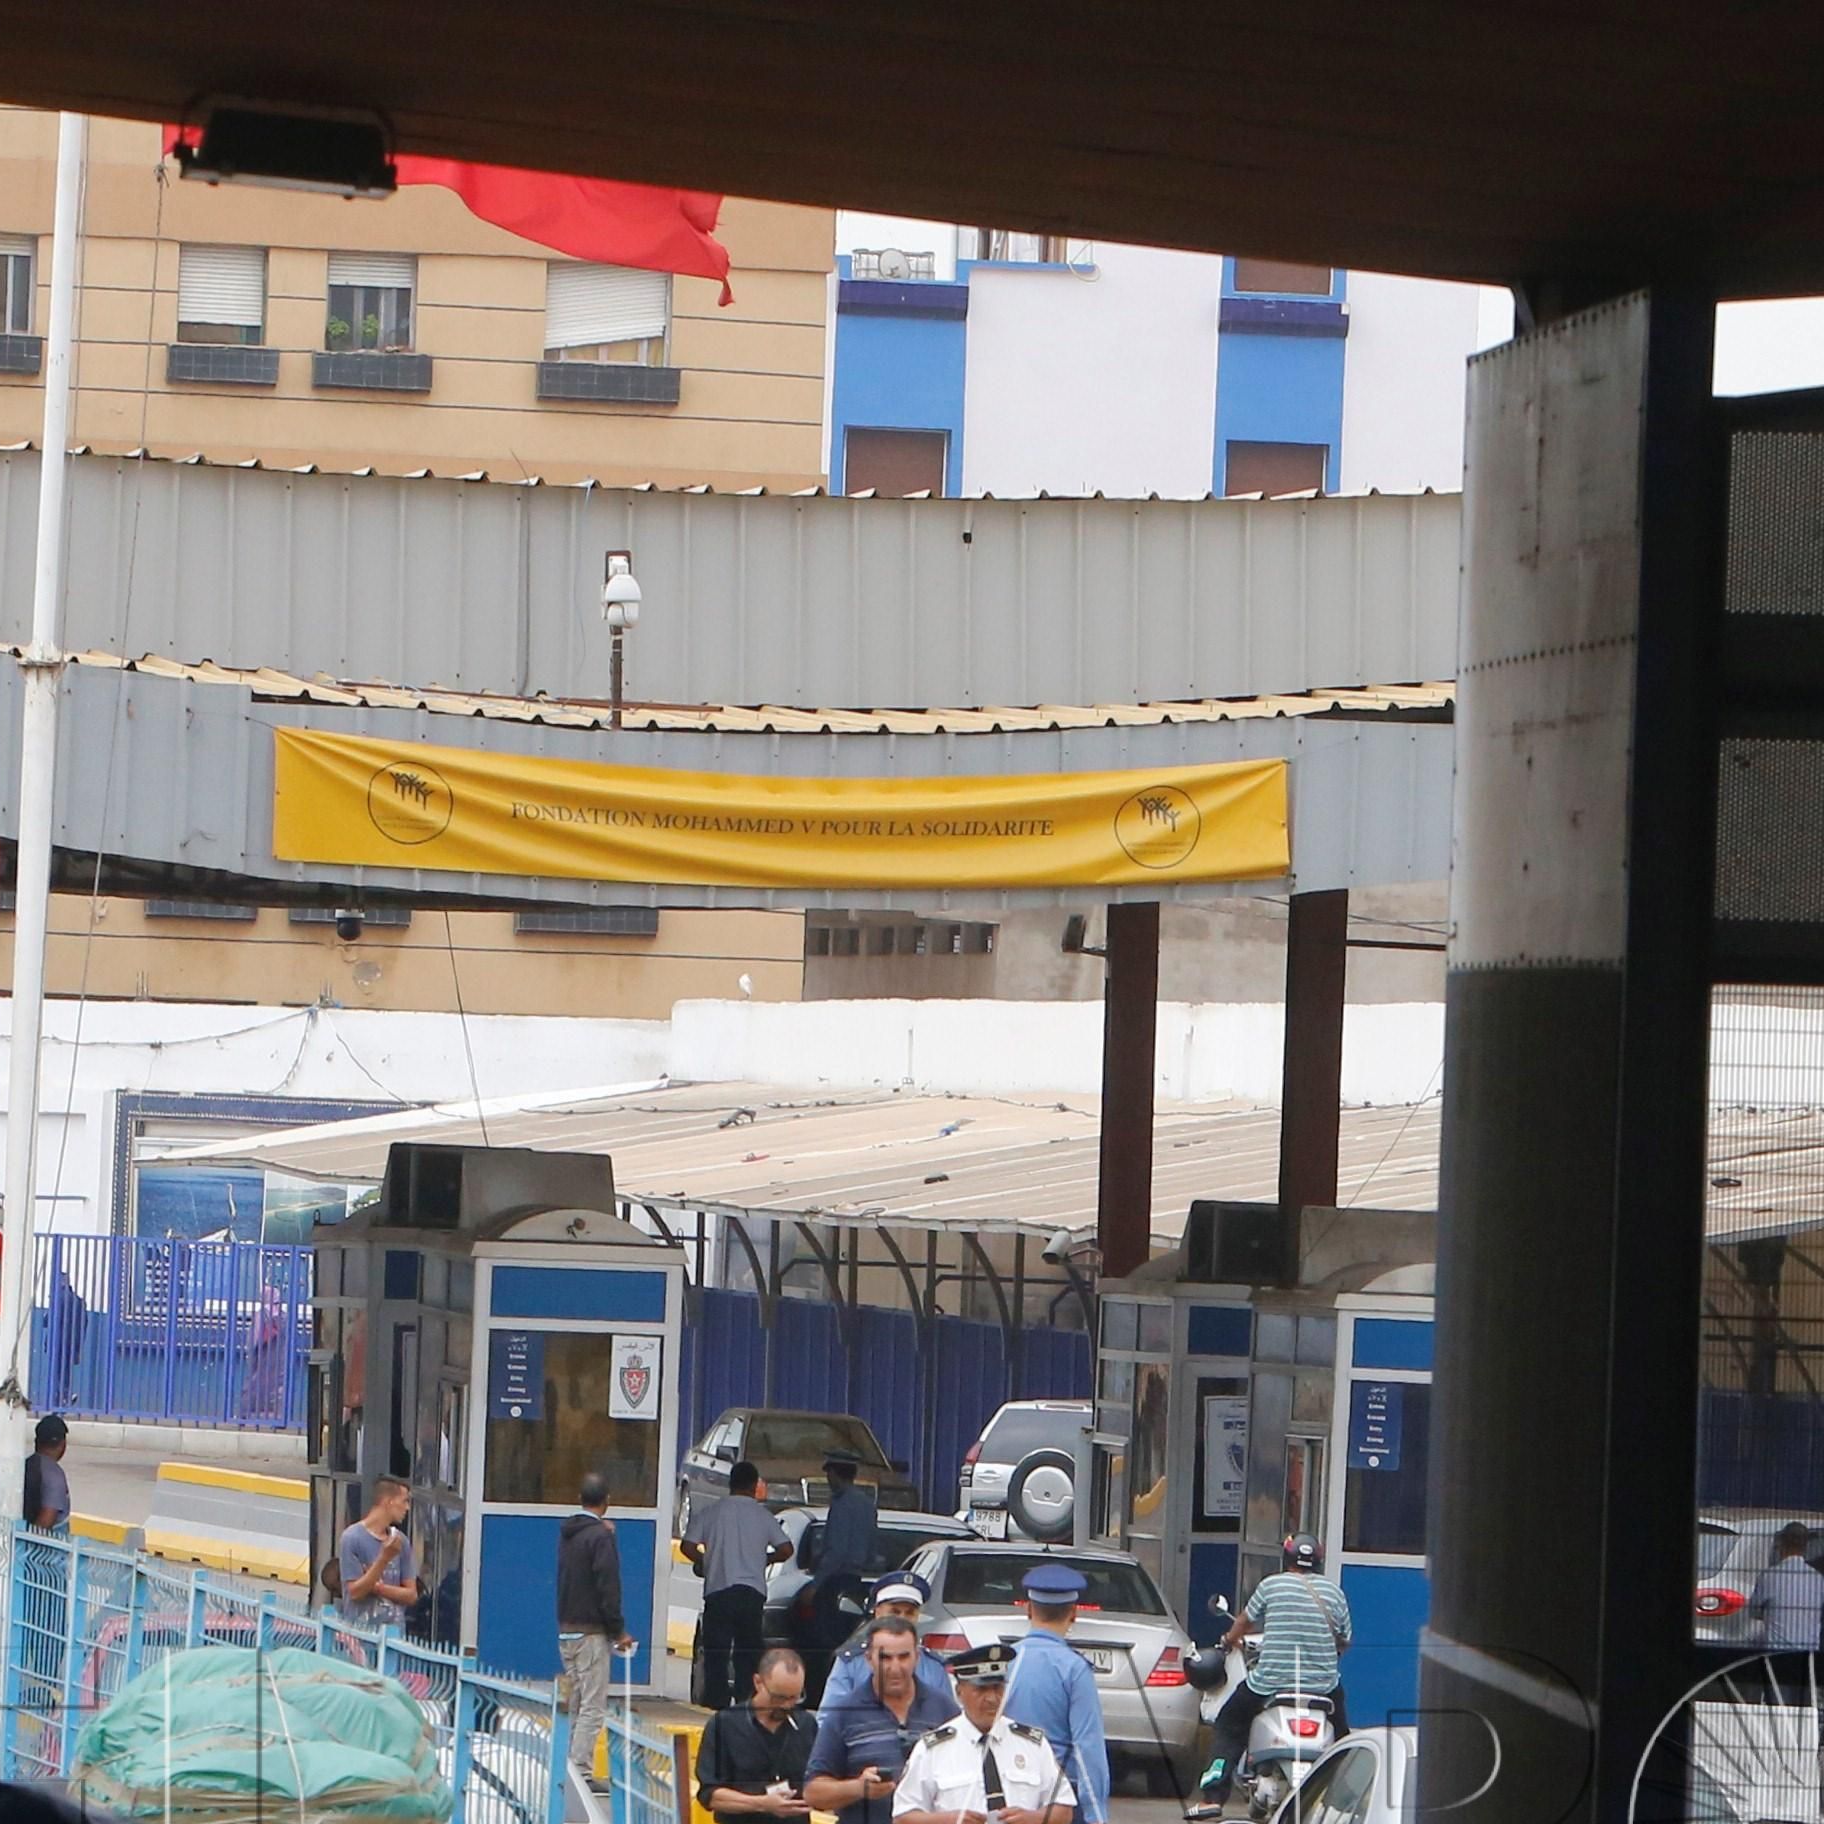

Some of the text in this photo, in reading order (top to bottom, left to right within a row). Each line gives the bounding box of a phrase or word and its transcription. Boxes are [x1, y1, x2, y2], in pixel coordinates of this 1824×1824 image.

[511, 801, 1055, 836] FONDATION MOHAMMED V POUR LA SOLIDARITE
